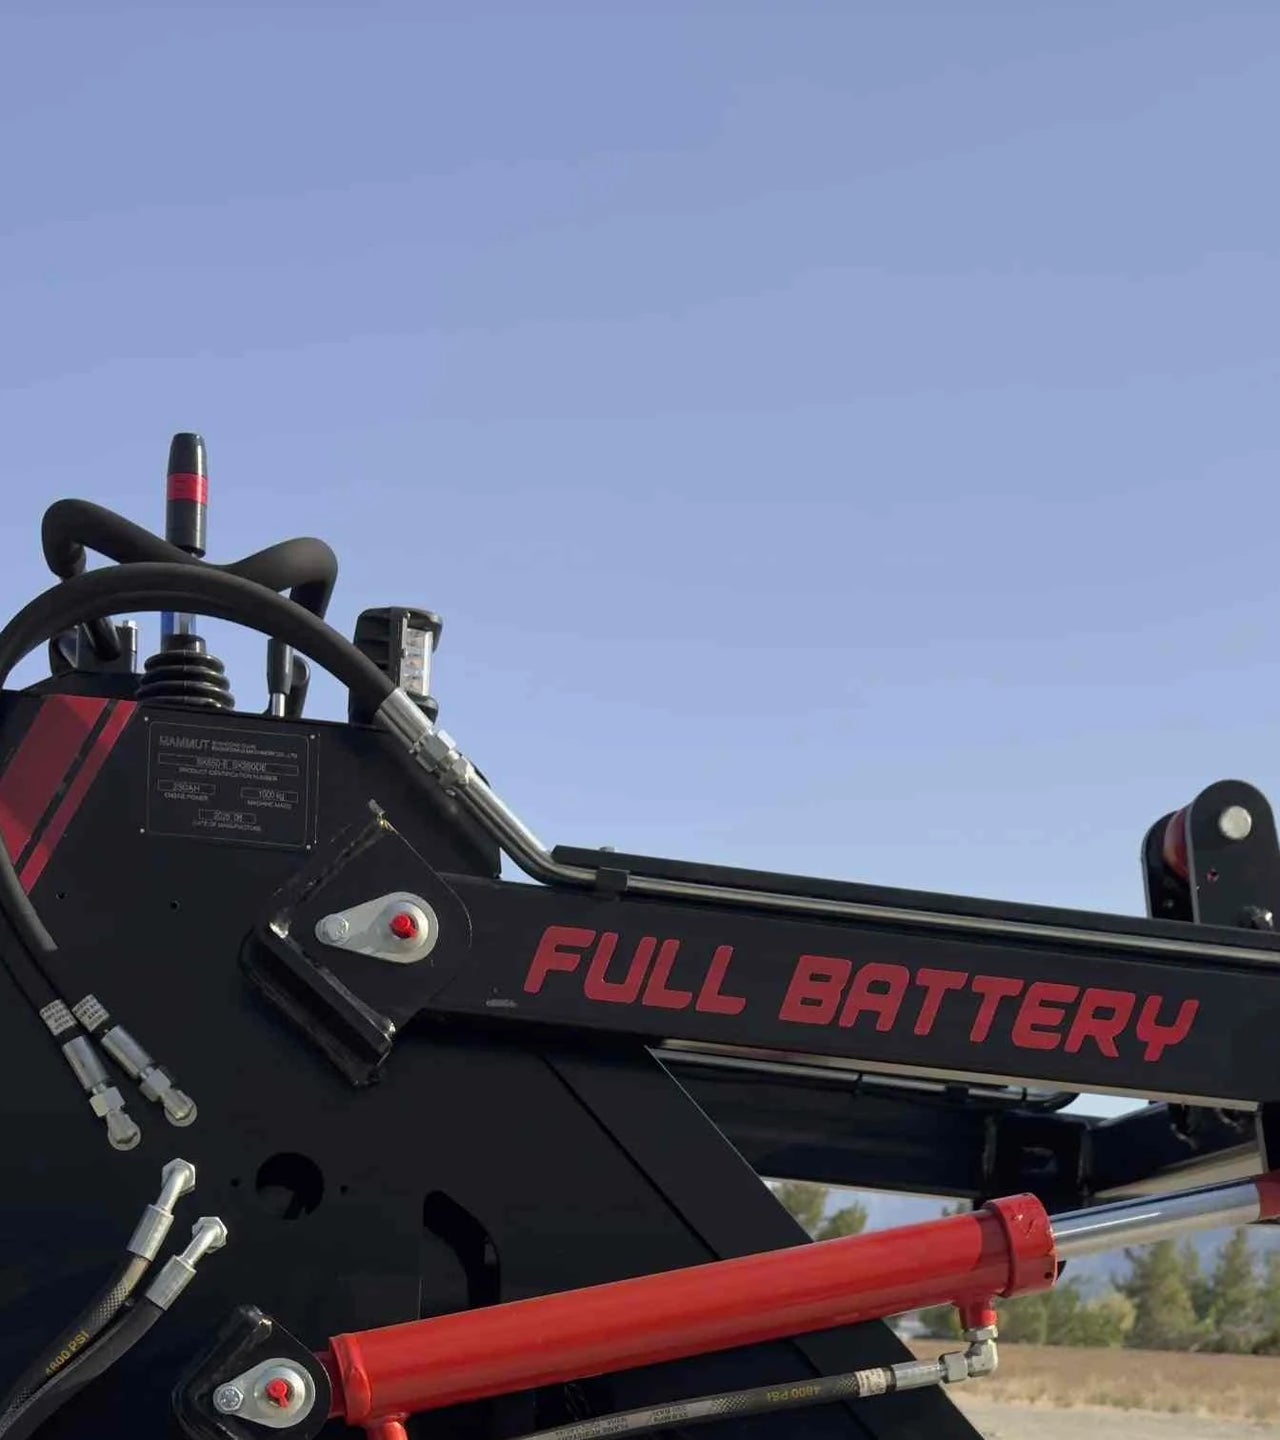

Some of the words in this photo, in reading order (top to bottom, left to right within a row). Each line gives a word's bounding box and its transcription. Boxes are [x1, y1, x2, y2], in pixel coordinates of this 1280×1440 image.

[160, 735, 211, 750] MAMMUT
[523, 925, 746, 1015] FULL
[778, 954, 1199, 1062] BATTERY
[68, 1330, 90, 1351] PSI
[767, 1390, 789, 1402] PSI
